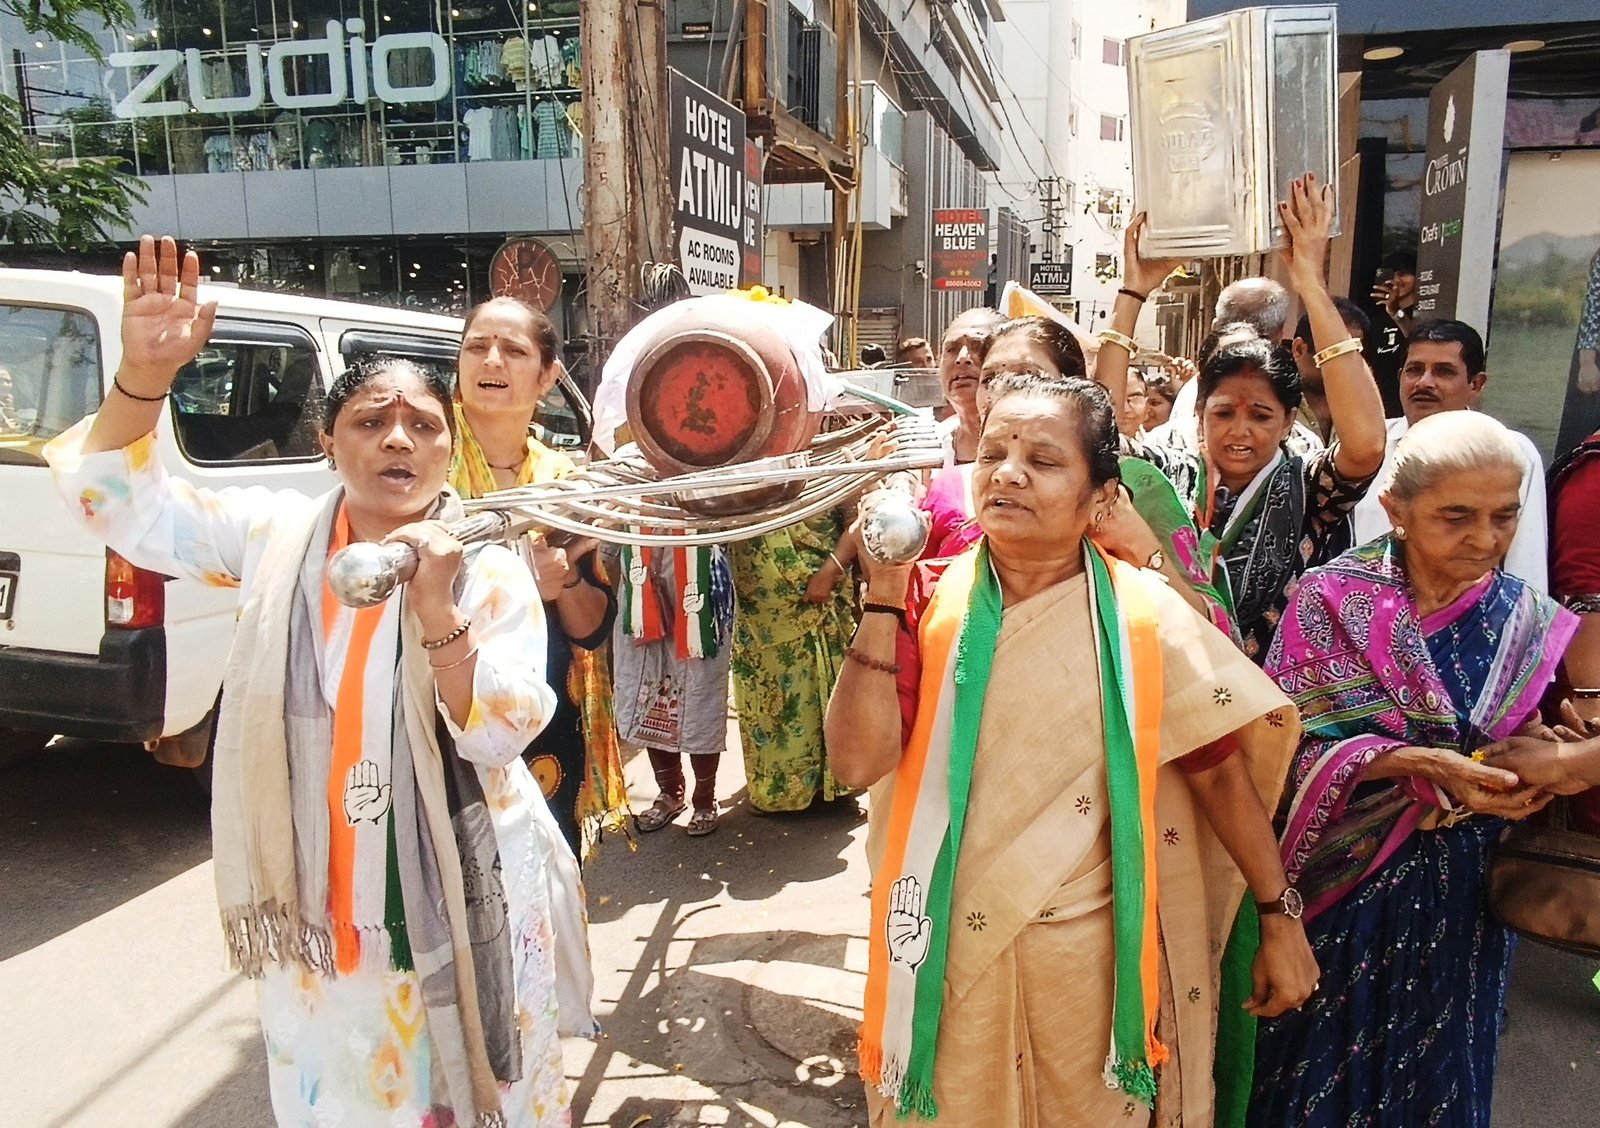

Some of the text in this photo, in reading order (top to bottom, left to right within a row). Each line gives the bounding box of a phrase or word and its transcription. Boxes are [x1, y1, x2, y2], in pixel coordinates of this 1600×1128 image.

[109, 17, 451, 118] zudio
[685, 95, 735, 155] HOTEL
[678, 146, 742, 229] ATMIJ
[744, 180, 760, 214] VEN
[936, 210, 984, 223] HOTEL
[935, 223, 985, 237] HEAVEN
[687, 240, 701, 259] AC
[703, 243, 735, 266] ROOMS
[943, 237, 976, 250] BLUE
[688, 267, 734, 289] AVAILABLE
[1032, 272, 1070, 284] ATMIJ
